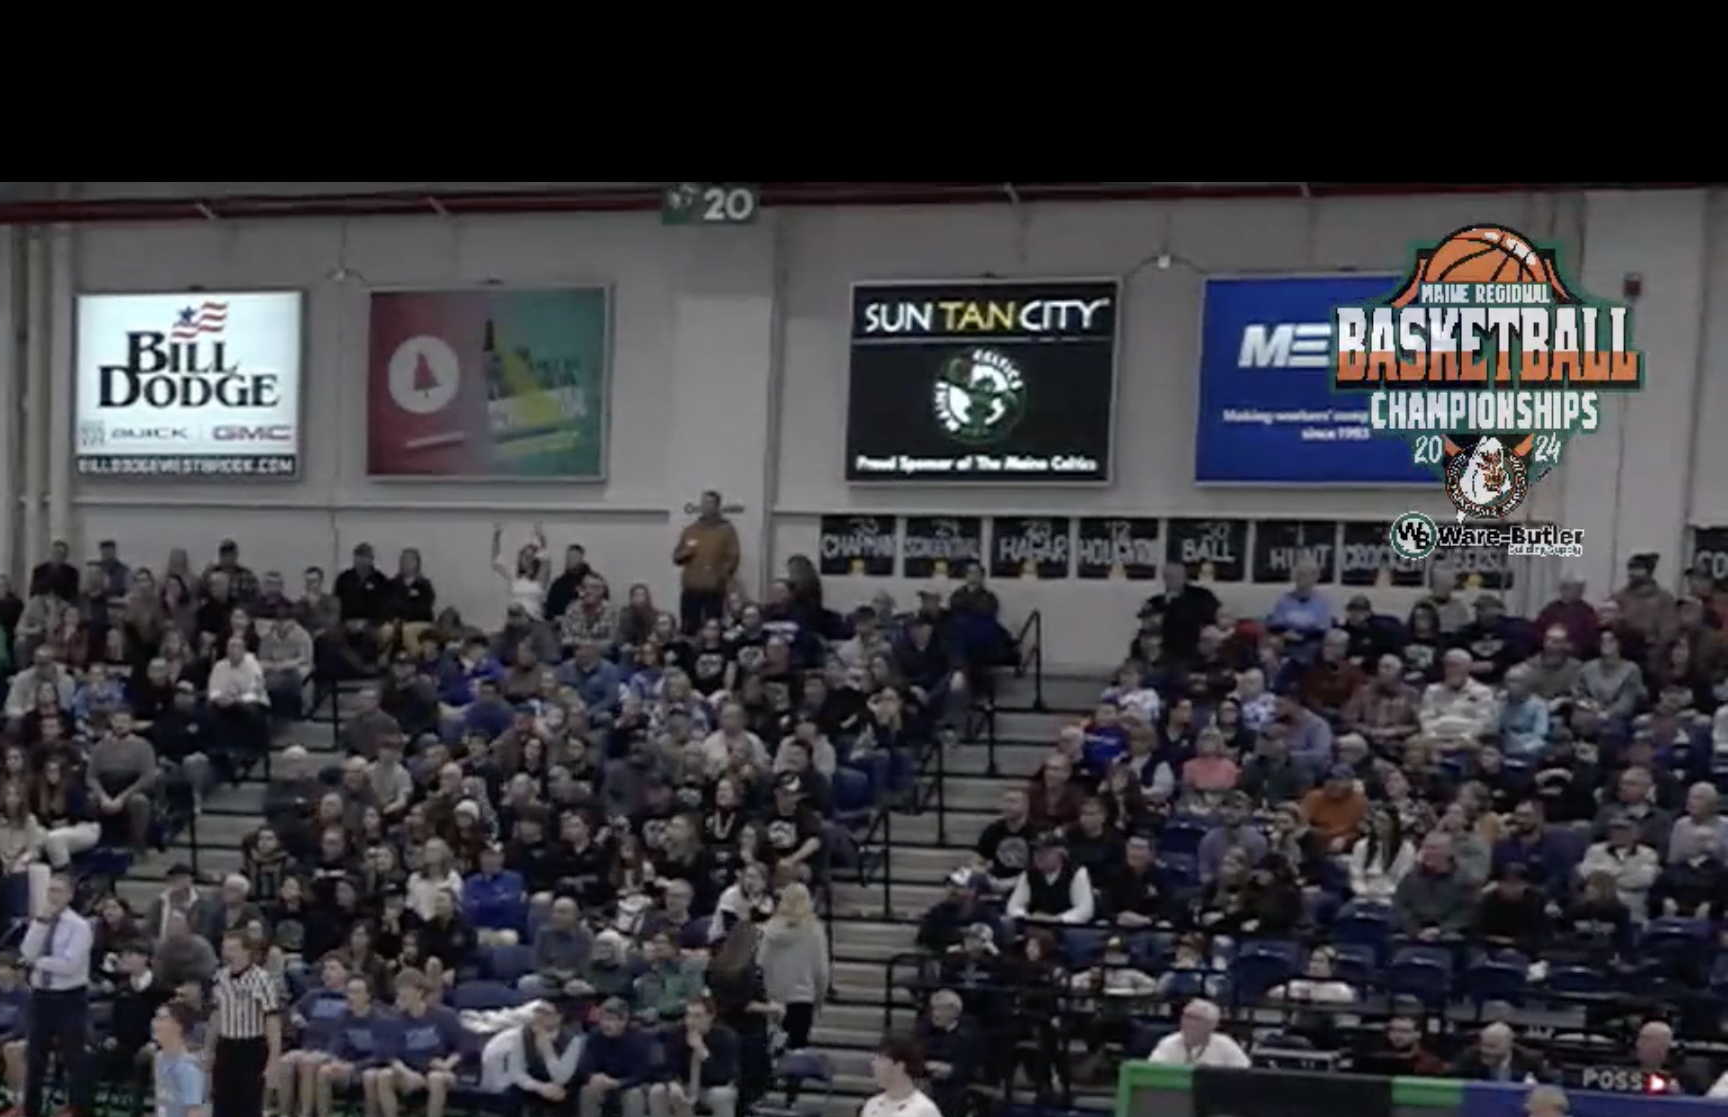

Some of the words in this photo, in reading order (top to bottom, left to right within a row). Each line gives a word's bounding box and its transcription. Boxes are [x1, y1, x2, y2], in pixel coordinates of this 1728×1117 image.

[704, 187, 754, 220] 20
[864, 301, 933, 333] SUN
[939, 302, 1015, 332] TAN
[1018, 298, 1110, 331] CITY
[126, 330, 241, 375] BILL
[98, 364, 282, 409] DODGE
[111, 426, 188, 440] BUICK
[212, 424, 292, 441] GMC
[855, 456, 897, 471] Proud
[898, 456, 954, 473] Sponsor
[956, 456, 972, 471] of
[974, 456, 1002, 471] The
[1004, 456, 1049, 471] Maine
[1181, 535, 1236, 563] BALL
[1582, 1067, 1643, 1091] POSS
